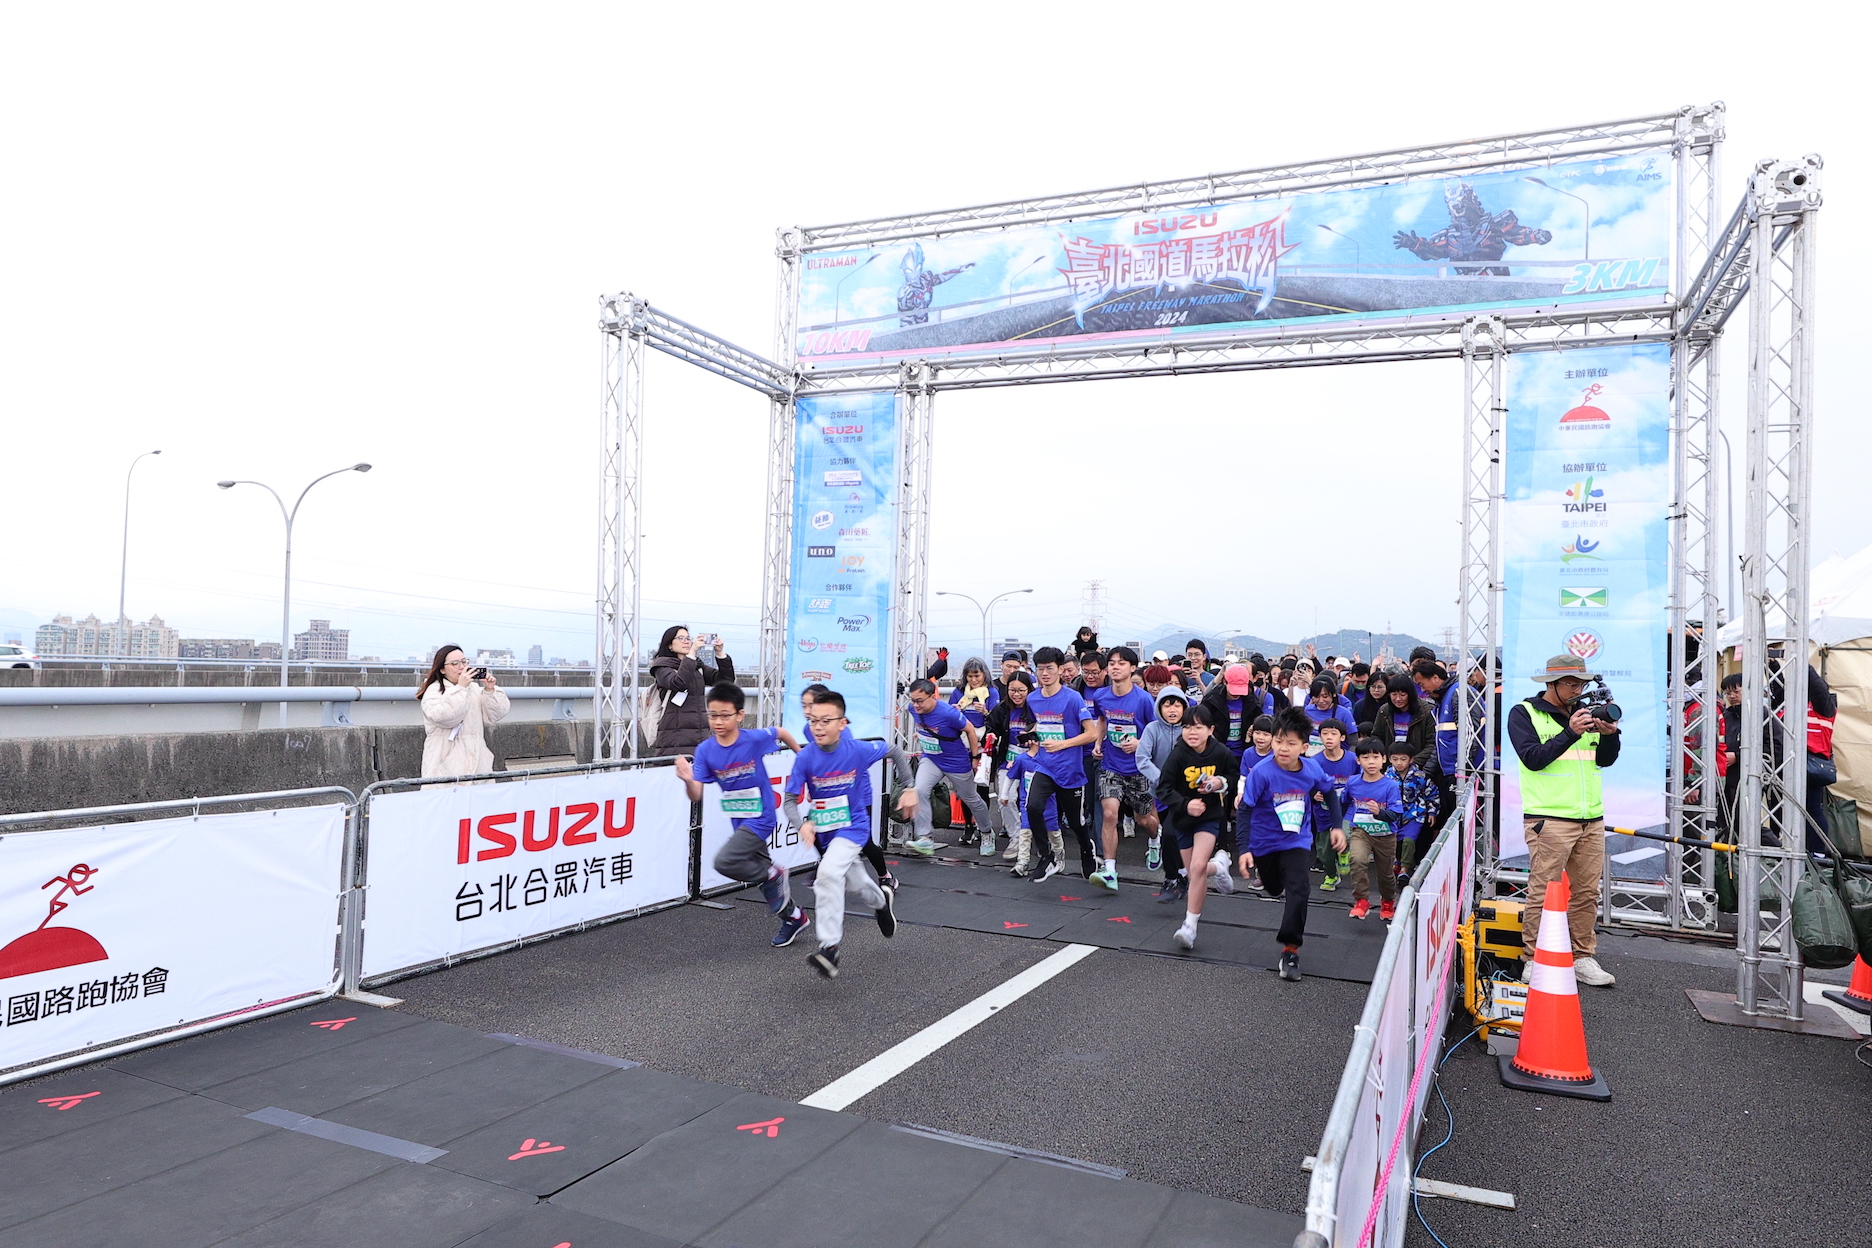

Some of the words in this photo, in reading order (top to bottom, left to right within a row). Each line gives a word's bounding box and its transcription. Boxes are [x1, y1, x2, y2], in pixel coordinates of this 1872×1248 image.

[1636, 172, 1662, 182] AIMS
[1134, 212, 1218, 236] ISUZU
[806, 256, 847, 271] ULTRAMAN
[1059, 212, 1296, 318] 臺北國道馬拉松
[1562, 257, 1661, 294] 3KM
[1100, 303, 1135, 315] TAIPEI
[1138, 298, 1187, 311] FREEWAY
[1188, 293, 1245, 307] MARATHON
[1154, 311, 1188, 326] 2024
[802, 328, 873, 356] 10KM
[1564, 368, 1609, 379] 主辦單位
[822, 425, 864, 435] ISUZU
[1562, 462, 1608, 473] 協辦單位
[1562, 502, 1607, 513] TAIPEI
[1560, 519, 1609, 529] 臺北市政府
[809, 547, 834, 556] uno
[825, 583, 853, 591] 合作夥伴
[837, 616, 866, 625] Power
[845, 662, 859, 670] TREE
[858, 660, 871, 668] TOP
[457, 797, 637, 865] ISUZU
[1357, 823, 1388, 833] 2454
[455, 852, 634, 922] 台北合眾汽車
[1426, 867, 1452, 982] ISUZU
[0, 966, 170, 1028] 國路跑協會
